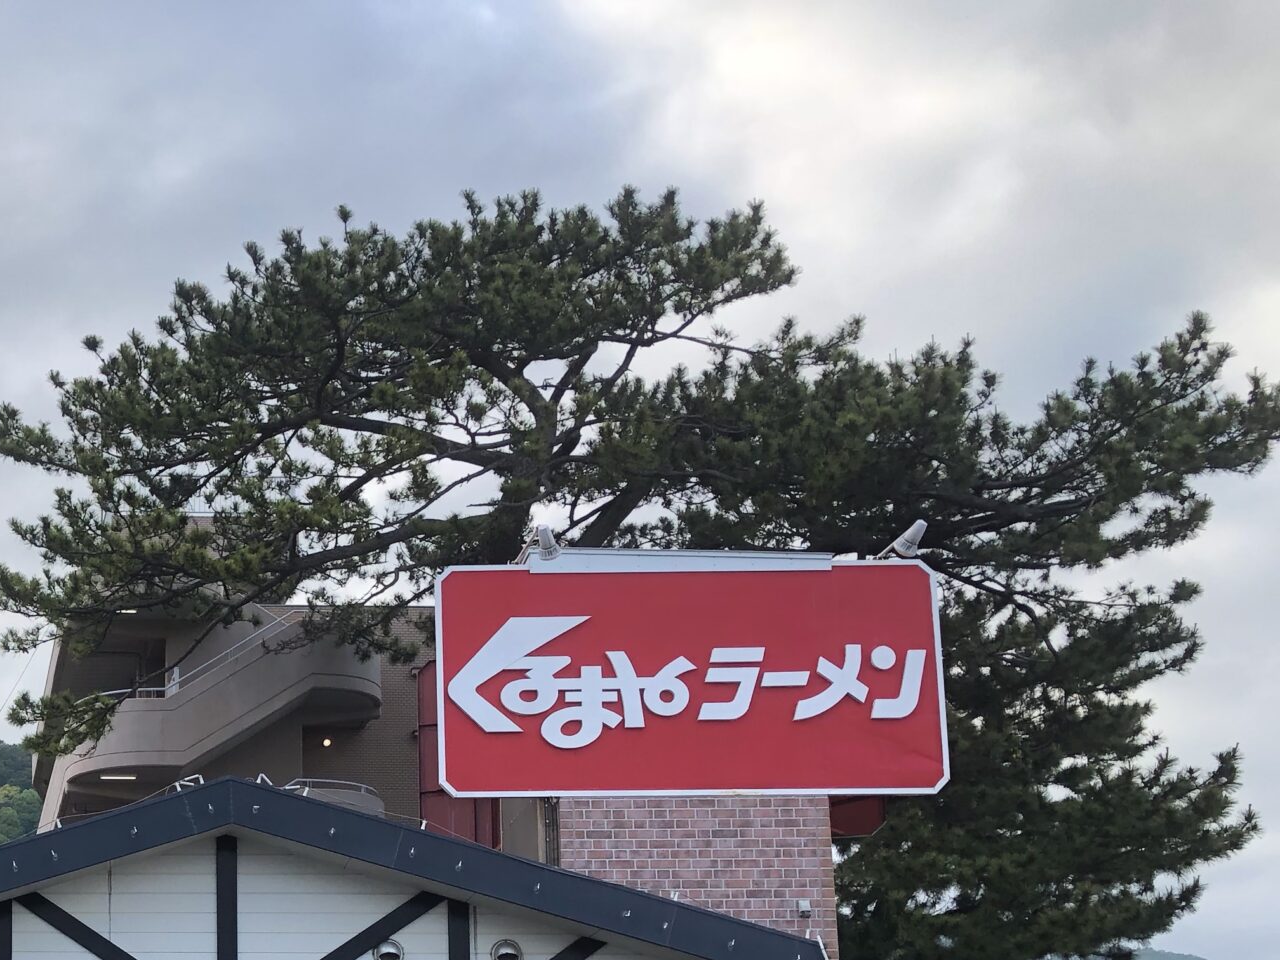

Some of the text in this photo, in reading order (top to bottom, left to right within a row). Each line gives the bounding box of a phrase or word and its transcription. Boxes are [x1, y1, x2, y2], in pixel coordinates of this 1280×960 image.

[447, 616, 927, 749] くるまやラーメン
